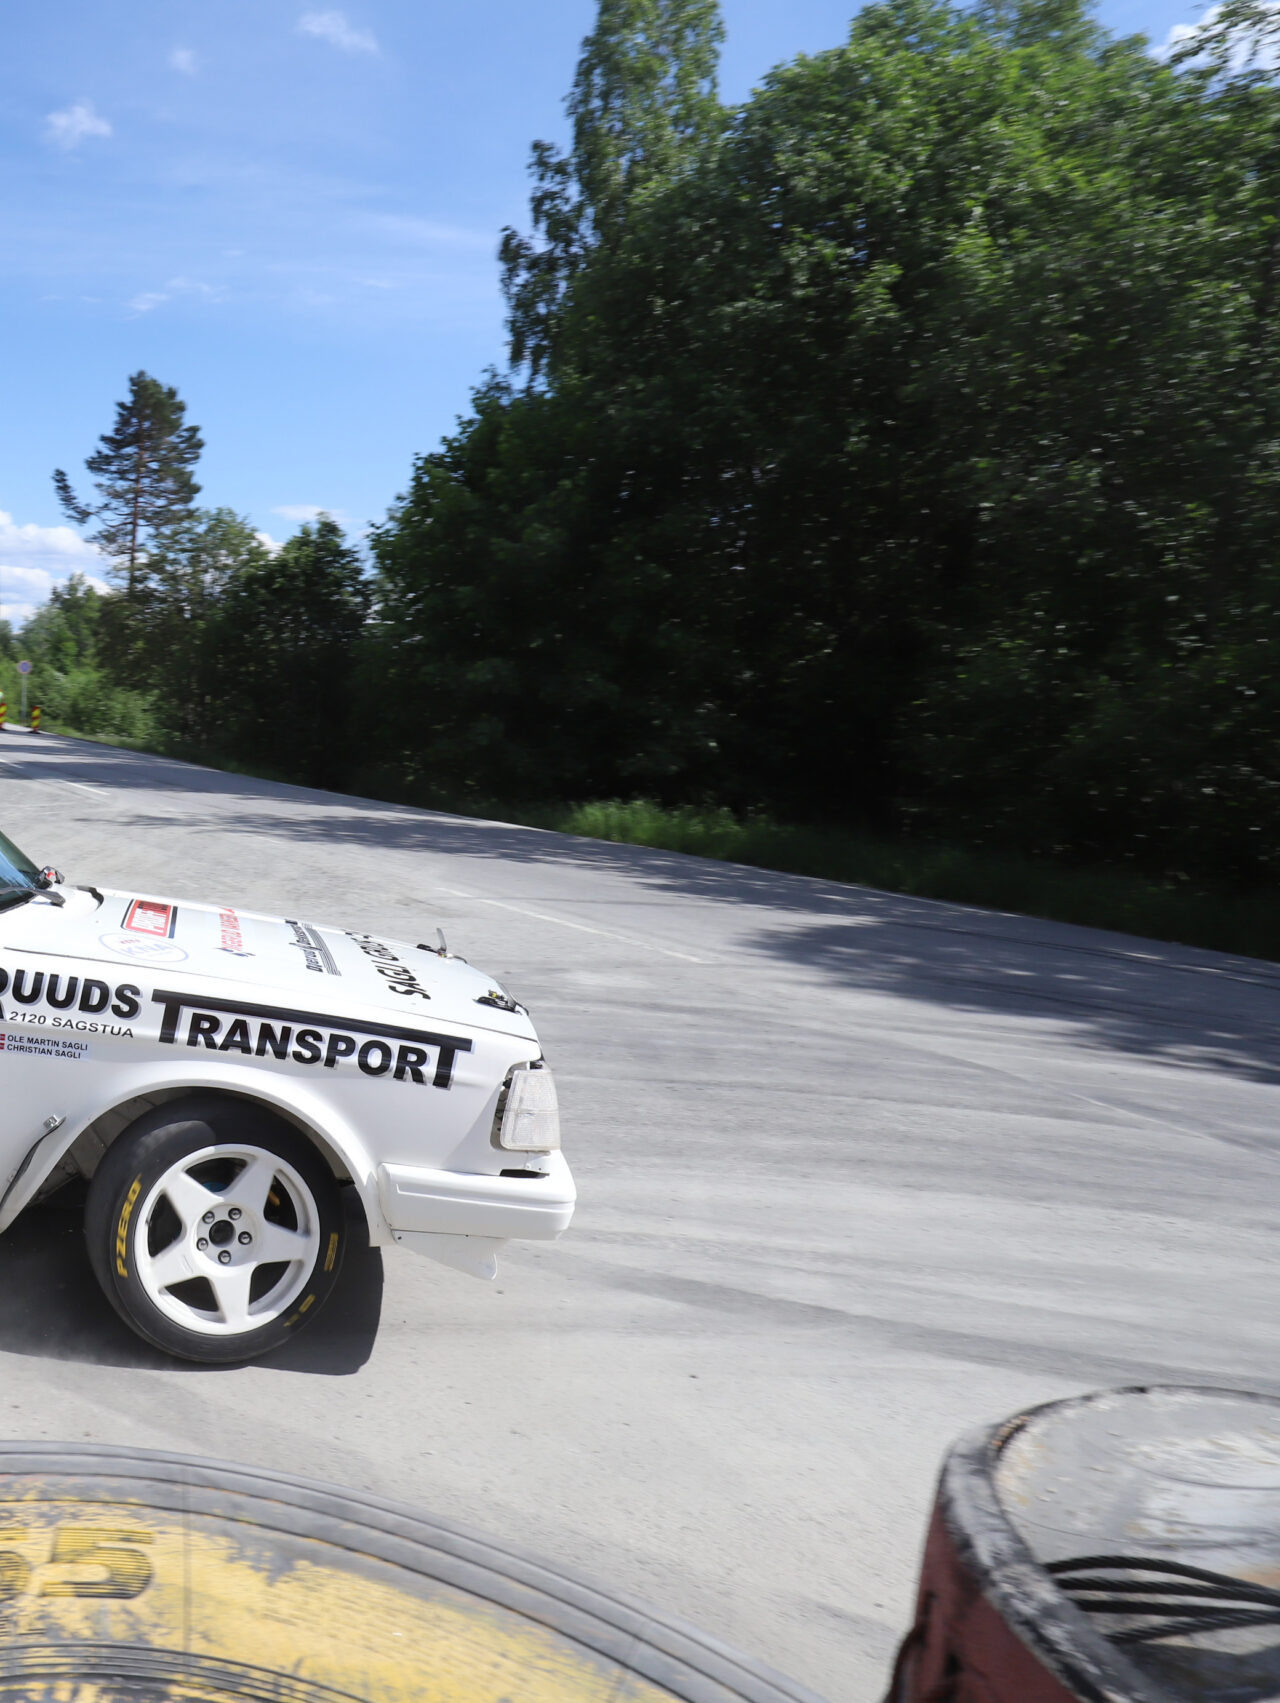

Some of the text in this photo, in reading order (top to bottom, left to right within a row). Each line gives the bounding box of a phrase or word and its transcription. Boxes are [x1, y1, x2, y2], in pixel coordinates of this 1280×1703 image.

[371, 960, 431, 1000] SAGLI
[9, 1011, 134, 1038] 2120 SAGSTUA
[6, 1043, 81, 1059] CHRISTIAN SAGLI
[7, 1034, 88, 1051] OLE MARTIN SAGLI
[151, 988, 474, 1091] TRANSPORT
